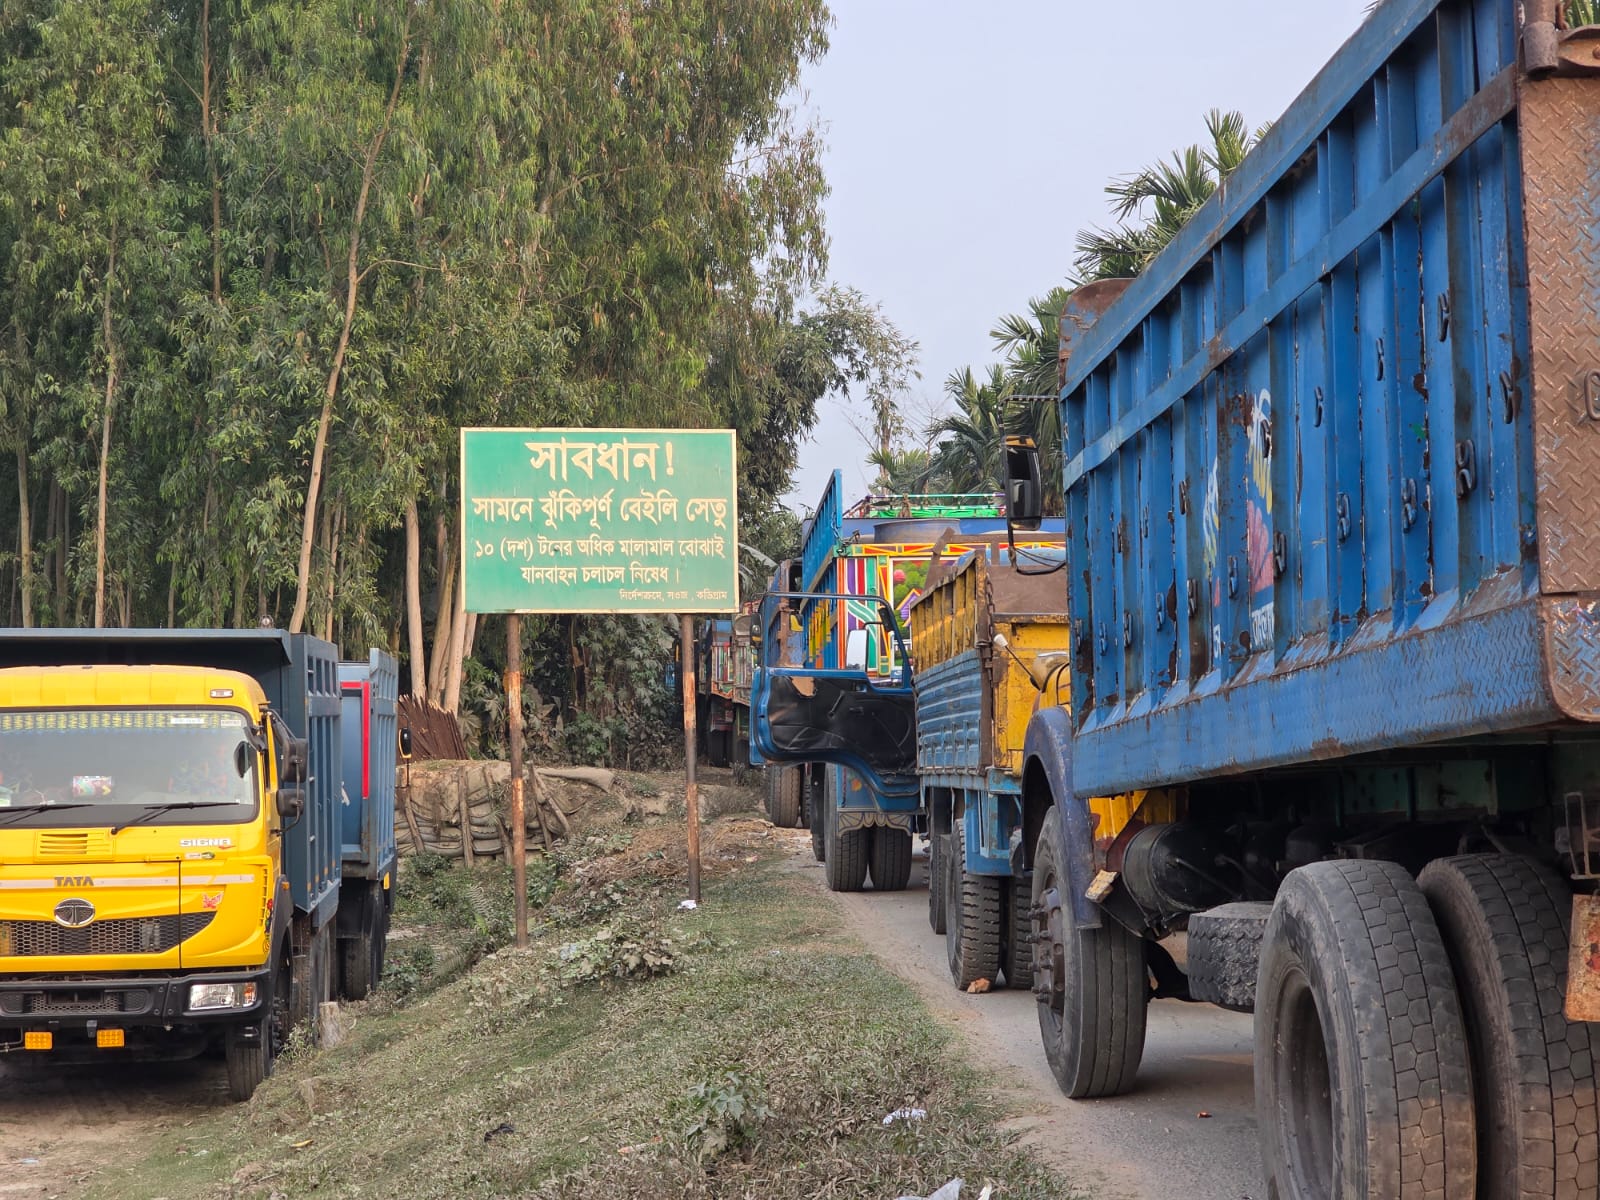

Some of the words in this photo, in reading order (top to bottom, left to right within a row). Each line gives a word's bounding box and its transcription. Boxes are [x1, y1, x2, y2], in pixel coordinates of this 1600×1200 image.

[471, 497, 535, 522] সামনে
[538, 488, 615, 530] ঝুঁকিপূর্ণ
[619, 489, 680, 526] বেইলি
[685, 497, 729, 531] সেতু
[475, 540, 494, 558] ১০
[500, 537, 534, 562] (দশ)
[536, 534, 574, 557] টনের
[575, 533, 616, 557] অধিক
[618, 538, 674, 557] মালামাল
[678, 533, 726, 559] বোঝাই
[519, 564, 578, 586] যানবাহন
[580, 565, 626, 584] চলাচল
[54, 876, 95, 887] TATA
